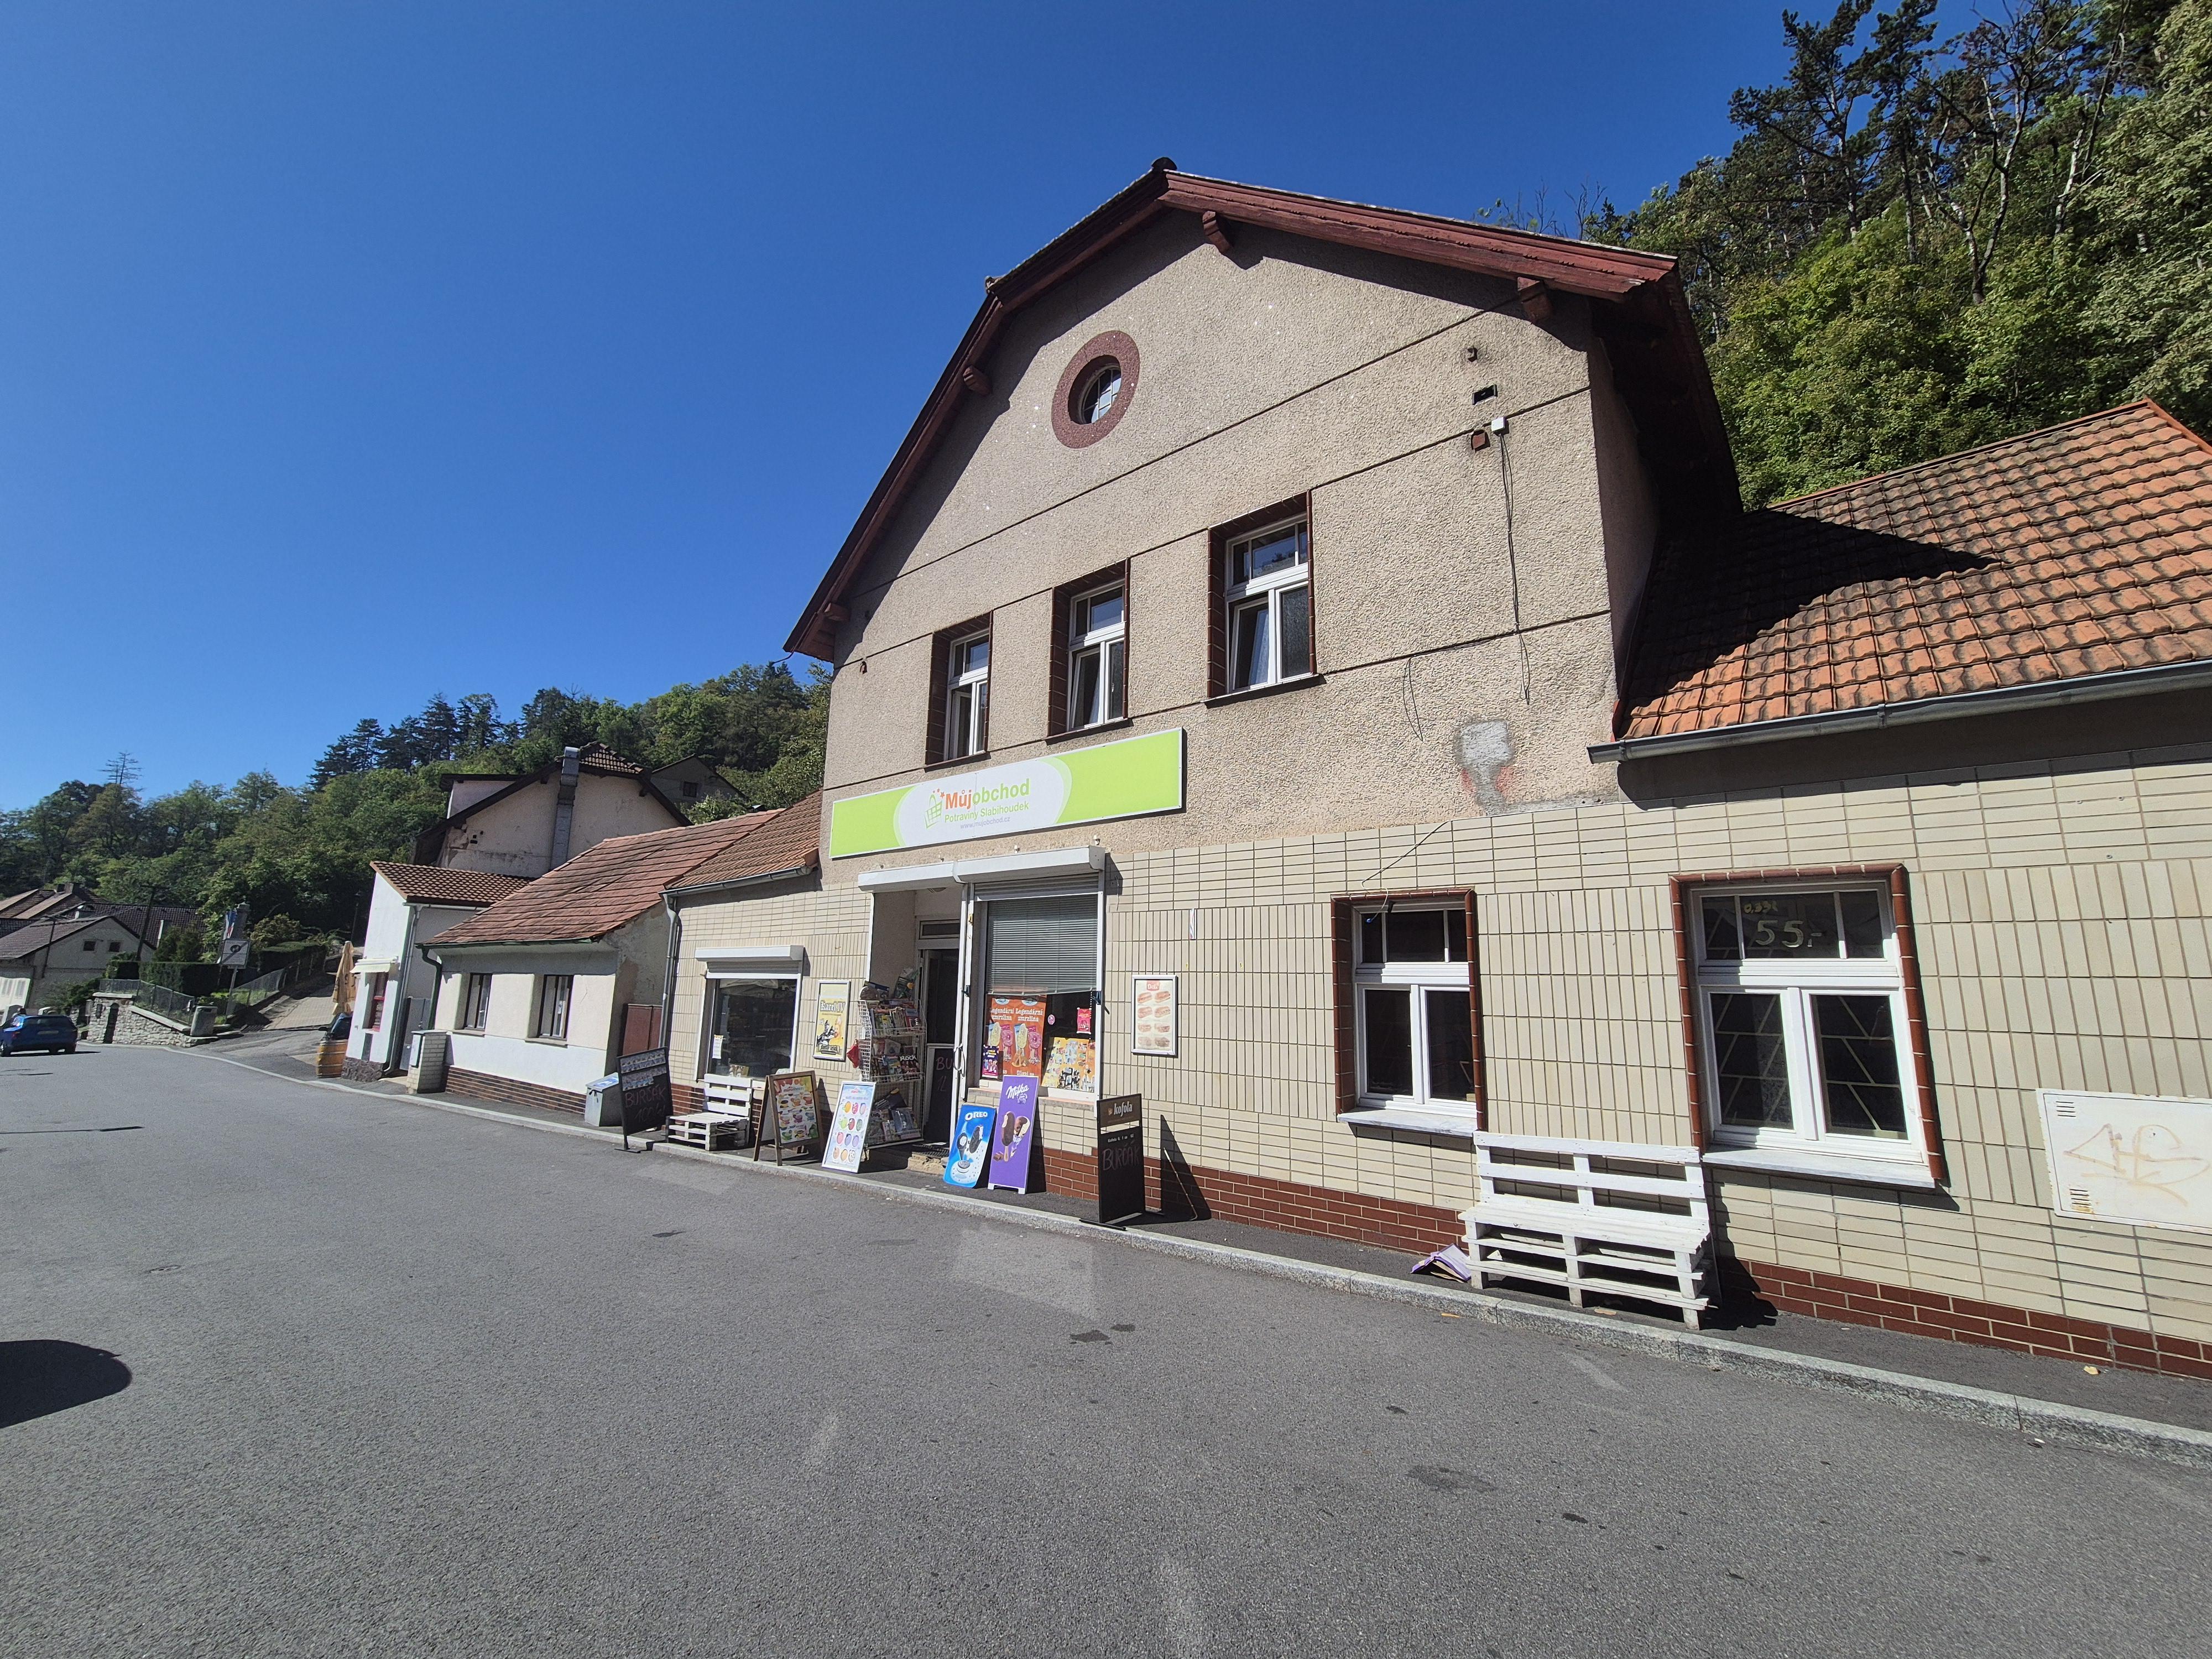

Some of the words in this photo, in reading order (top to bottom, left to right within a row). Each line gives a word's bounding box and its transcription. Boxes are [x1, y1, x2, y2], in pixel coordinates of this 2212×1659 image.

[945, 779, 1030, 810] Můjobchod
[945, 811, 978, 823] Potraviny
[980, 801, 1029, 817] Slabihoudek
[960, 816, 1010, 829] www.mujobchod.cz
[820, 1000, 836, 1011] Karel
[837, 1002, 846, 1012] IV
[1006, 1084, 1029, 1099] Milka
[964, 1111, 988, 1121] OREO
[1114, 1101, 1133, 1117] kofola
[1102, 1140, 1141, 1170] BURČÁK
